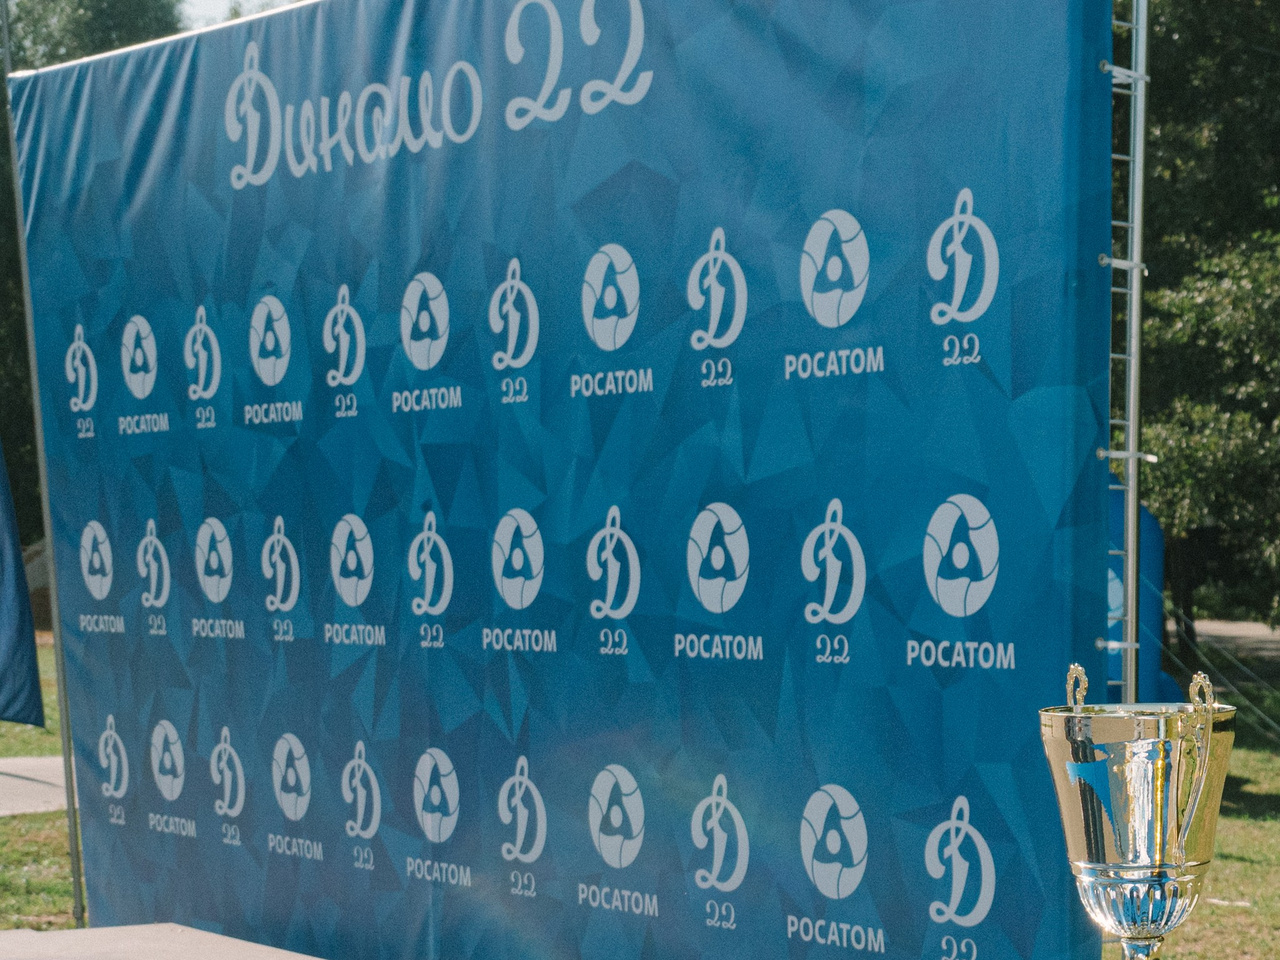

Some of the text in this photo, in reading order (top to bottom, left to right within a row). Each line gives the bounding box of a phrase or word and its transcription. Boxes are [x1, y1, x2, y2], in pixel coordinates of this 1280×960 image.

[224, 0, 654, 190] Динамо 22
[784, 346, 884, 380] РОСАТОМ
[942, 333, 981, 367] 22
[570, 367, 653, 398] РОСАТОМ
[701, 357, 733, 388] 22
[392, 386, 462, 413] РОСАТОМ
[501, 377, 529, 404] 22
[195, 406, 216, 429] 22
[244, 400, 303, 424] РОСАТОМ
[334, 393, 358, 418] 22
[77, 418, 94, 438] 22
[118, 413, 169, 435] РОСАТОМ
[79, 614, 125, 633] РОСАТОМ
[149, 616, 166, 635] 22
[192, 618, 244, 638] РОСАТОМ
[273, 620, 294, 641] 22
[324, 623, 386, 645] РОСАТОМ
[420, 624, 444, 648] 22
[482, 628, 557, 652] РОСАТОМ
[599, 628, 628, 655] 22
[674, 633, 763, 660] РОСАТОМ
[815, 634, 850, 664] 22
[906, 639, 1016, 670] РОСАТОМ
[109, 805, 125, 825] 22
[149, 813, 196, 837] РОСАТОМ
[222, 824, 241, 846] 22
[268, 834, 323, 860] РОСАТОМ
[354, 846, 375, 870] 22
[406, 857, 472, 887] РОСАТОМ
[510, 871, 536, 897] 22
[578, 883, 659, 917] РОСАТОМ
[706, 900, 736, 929] 22
[787, 915, 885, 953] РОСАТОМ
